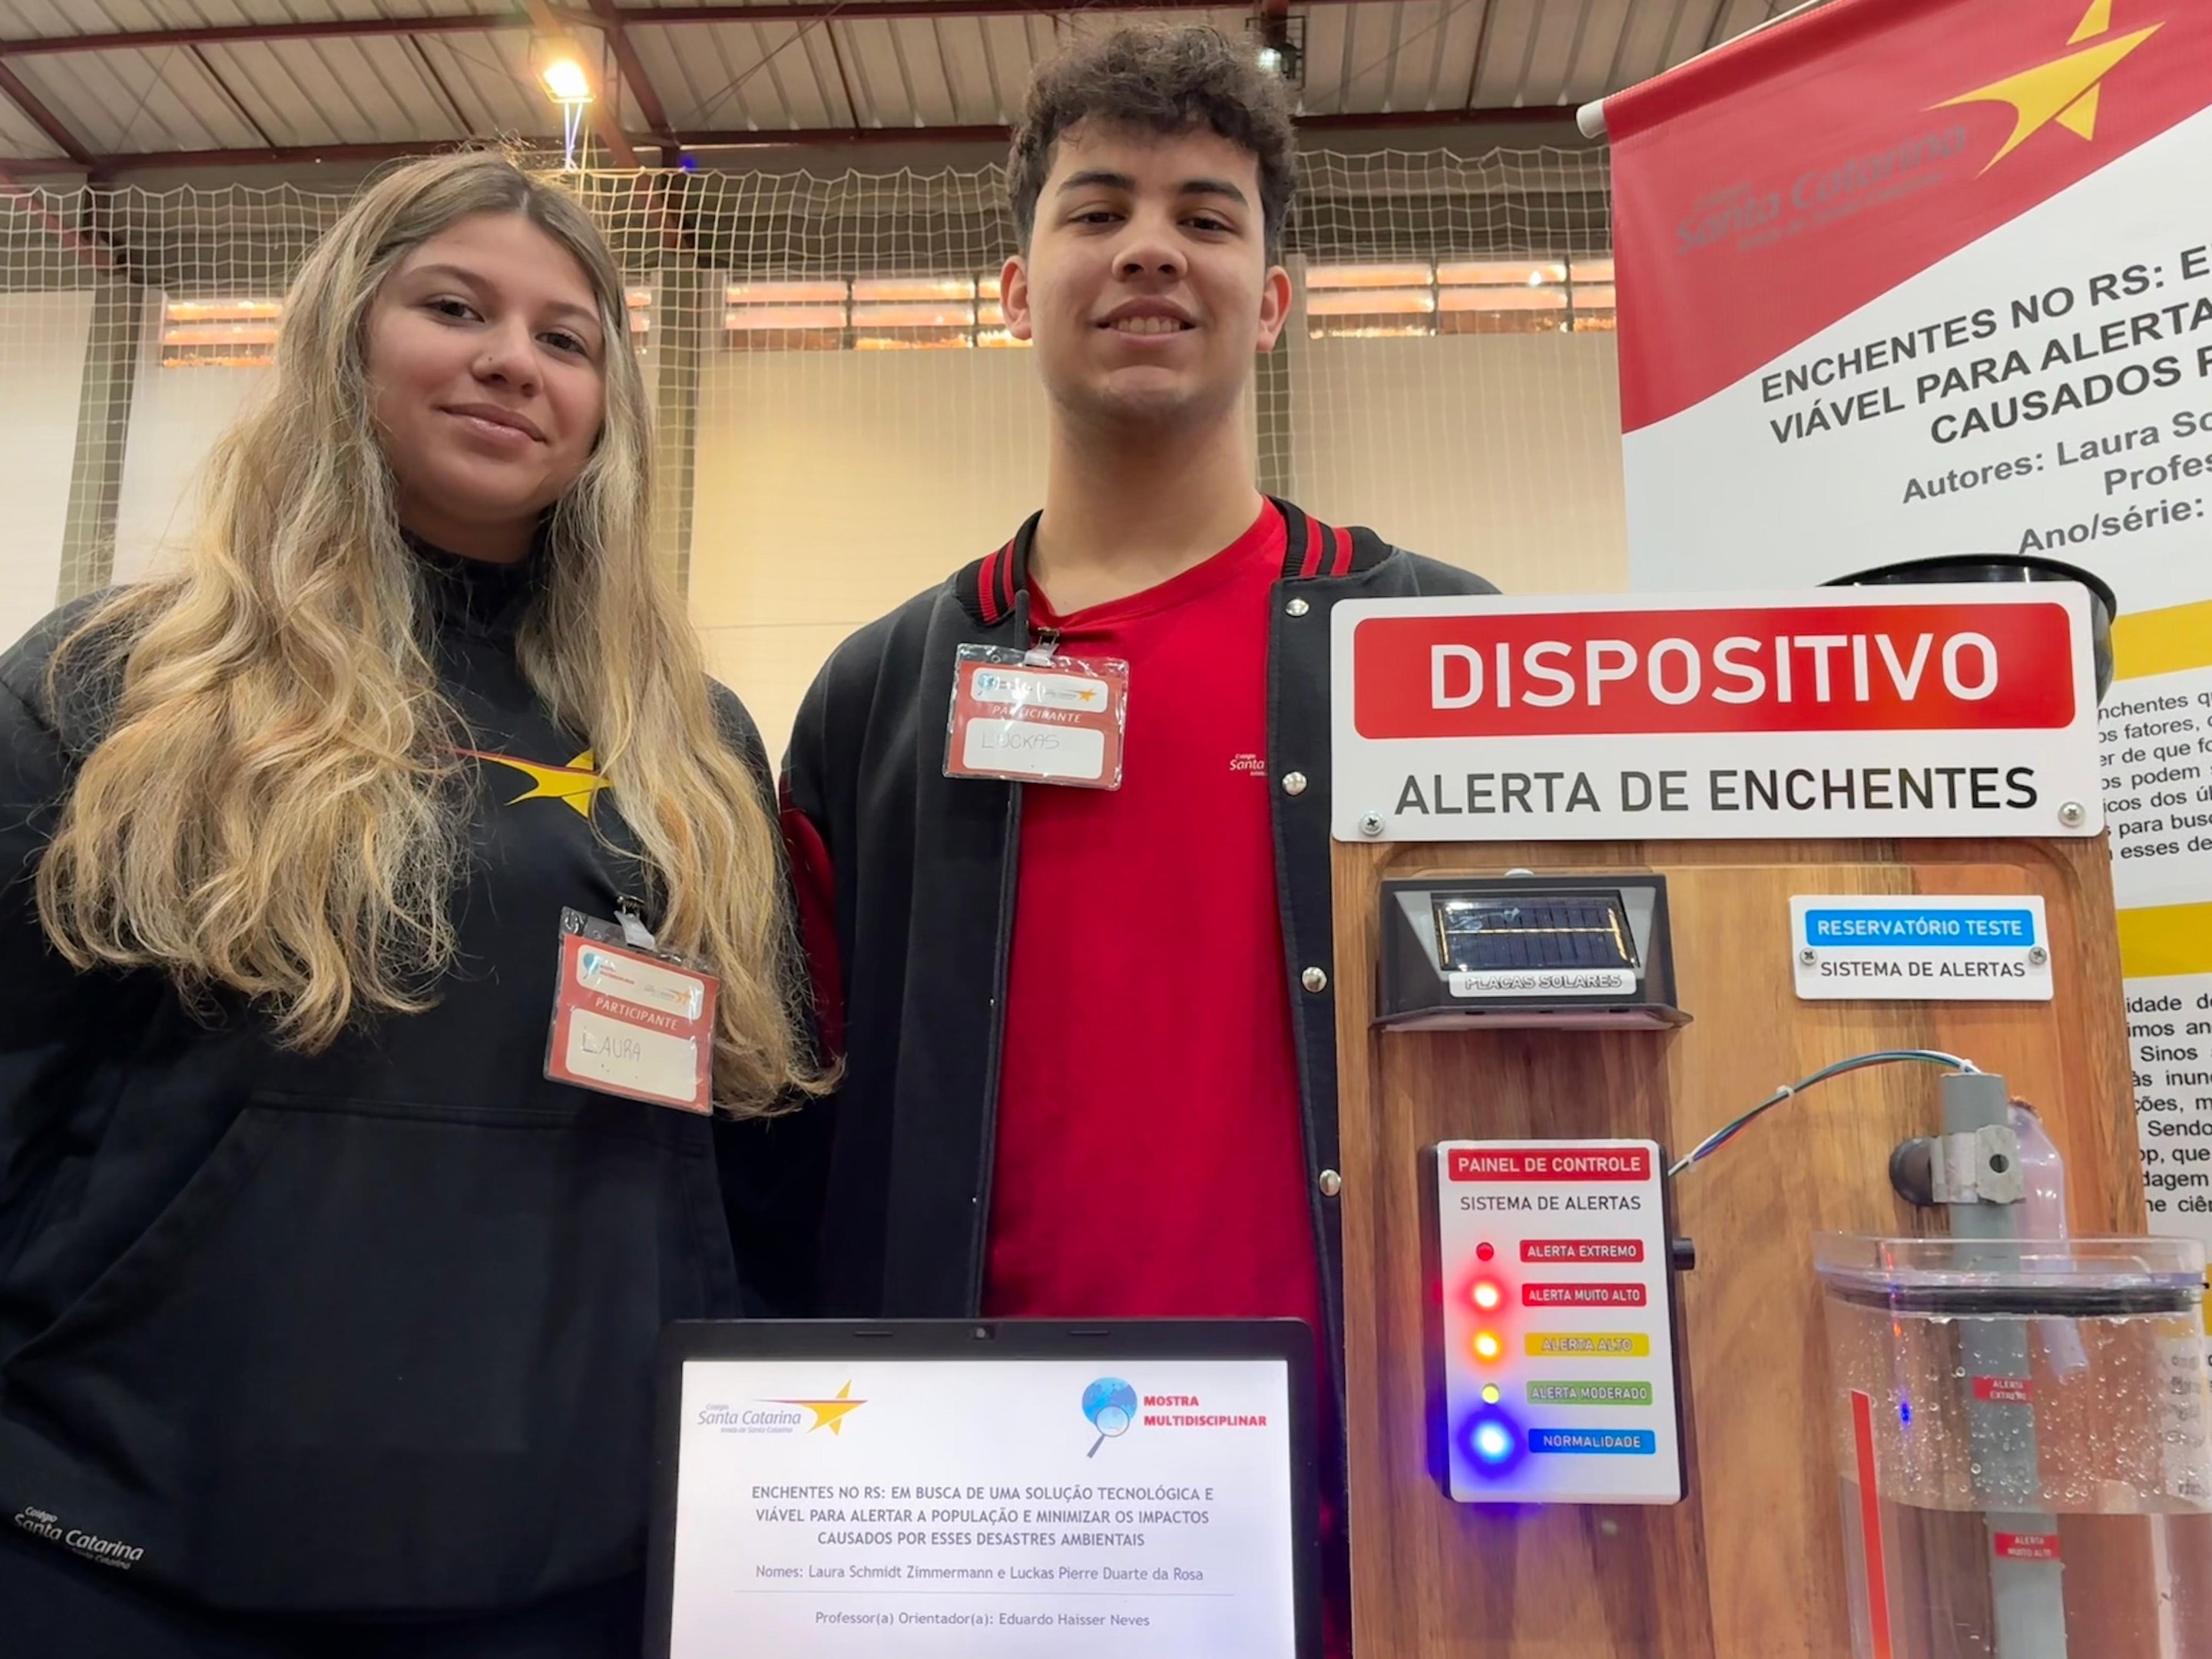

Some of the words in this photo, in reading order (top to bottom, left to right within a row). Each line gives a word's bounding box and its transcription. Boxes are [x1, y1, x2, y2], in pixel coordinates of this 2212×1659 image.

[1762, 309, 1997, 403] ENCHENTES
[2011, 286, 2075, 329] NO
[2089, 264, 2164, 306] RS:
[2181, 243, 2212, 280] E
[1770, 386, 1906, 444] VIÁVEL
[1917, 350, 2032, 404] PARA
[2040, 297, 2212, 372] ALERTA
[1931, 356, 2181, 444] CAUSADOS
[1902, 452, 2045, 504] Autores:
[2057, 425, 2161, 466] Laura
[2018, 498, 2204, 555] Ano/série:
[1431, 632, 1996, 710] DISPOSITIVO
[2124, 719, 2200, 739] fatores,
[982, 733, 1060, 750] LUCKAS
[2121, 747, 2146, 763] de
[2154, 743, 2190, 762] que
[1230, 759, 1265, 770] Santa
[2131, 767, 2200, 790] podem
[1396, 773, 1601, 816] ALERTA
[1622, 770, 1688, 812] DE
[1710, 766, 2037, 811] ENCHENTES
[2151, 791, 2187, 807] dos
[2119, 820, 2163, 839] para
[2121, 842, 2180, 859] esses
[2187, 836, 2212, 852] de
[1817, 916, 1960, 935] RESERVATÓRIO
[1965, 920, 2023, 935] TESTE
[1821, 962, 1902, 977] SISTEMA
[1909, 962, 1933, 976] DE
[1940, 962, 2025, 977] ALERTAS
[1465, 976, 1535, 990] PLACAS
[1538, 975, 1622, 988] SOLARES
[2126, 995, 2182, 1012] idade
[595, 997, 679, 1030] PARTICIPANTE
[2127, 1022, 2175, 1037] imos
[581, 1031, 641, 1062] LAURA
[2141, 1045, 2198, 1062] Sinos
[2166, 1070, 2212, 1086] inun
[2147, 1120, 2212, 1137] Sendo
[1459, 1157, 1519, 1172] PAINEL
[1525, 1157, 1547, 1172] DE
[1552, 1157, 1641, 1172] CONTROLE
[2172, 1148, 2210, 1165] que
[1460, 1197, 1532, 1210] SISTEMA
[1538, 1197, 1559, 1210] DE
[1565, 1196, 1641, 1210] ALERTAS
[1527, 1246, 1575, 1257] ALERTA
[1579, 1246, 1637, 1257] EXTREMO
[1528, 1290, 1571, 1301] ALERTA
[1575, 1290, 1608, 1300] MUITO
[1612, 1290, 1640, 1300] ALTO
[1541, 1338, 1594, 1351] ALERTA
[1598, 1338, 1633, 1351] ALTO
[1144, 1396, 1199, 1406] MOSTRA
[1532, 1387, 1577, 1399] ALERTA
[1581, 1387, 1647, 1399] MODERADO
[697, 1411, 738, 1425] Santa
[742, 1410, 801, 1425] Catarina
[1144, 1416, 1267, 1426] MULTIDISCIPLINAR
[1543, 1435, 1641, 1448] NORMALIDADE
[752, 1486, 833, 1499] ENCHENTES
[839, 1486, 859, 1499] NO
[864, 1487, 885, 1499] RS:
[892, 1487, 911, 1499] EM
[916, 1487, 962, 1499] BUSCA
[967, 1487, 984, 1499] DE
[990, 1487, 1021, 1500] UMA
[1025, 1485, 1093, 1503] SOLUÇÃO
[1098, 1485, 1200, 1500] TECNOLÓGICA
[1206, 1488, 1214, 1500] E
[756, 1506, 805, 1522] VIÁVEL
[810, 1509, 846, 1522] PARA
[850, 1509, 912, 1522] ALERTAR
[917, 1510, 926, 1522] A
[932, 1508, 1018, 1525] POPULAÇÃO
[1024, 1510, 1031, 1522] E
[1036, 1510, 1111, 1523] MINIMIZAR
[1115, 1511, 1134, 1523] OS
[1139, 1511, 1209, 1524] IMPACTOS
[15, 1513, 63, 1541] Santa
[65, 1529, 144, 1561] Catarina
[817, 1532, 892, 1545] CAUSADOS
[898, 1532, 926, 1545] POR
[932, 1532, 972, 1545] ESSES
[977, 1533, 1055, 1545] DESASTRES
[1061, 1534, 1145, 1546] AMBIENTAIS
[756, 1565, 803, 1578] Nomes:
[809, 1565, 845, 1578] Laura
[849, 1565, 902, 1578] Schmidt
[907, 1566, 993, 1579] Zimmermann
[998, 1570, 1006, 1579] e
[1010, 1567, 1055, 1579] Luckas
[1059, 1567, 1098, 1580] Pierre
[1103, 1567, 1147, 1580] Duarte
[1152, 1568, 1169, 1580] da
[1174, 1568, 1204, 1581] Rosa
[816, 1611, 895, 1625] Professor(a)
[899, 1612, 994, 1626] Orientador(a):
[999, 1613, 1054, 1626] Eduardo
[1058, 1614, 1106, 1626] Haisser
[1111, 1614, 1151, 1627] Neves
